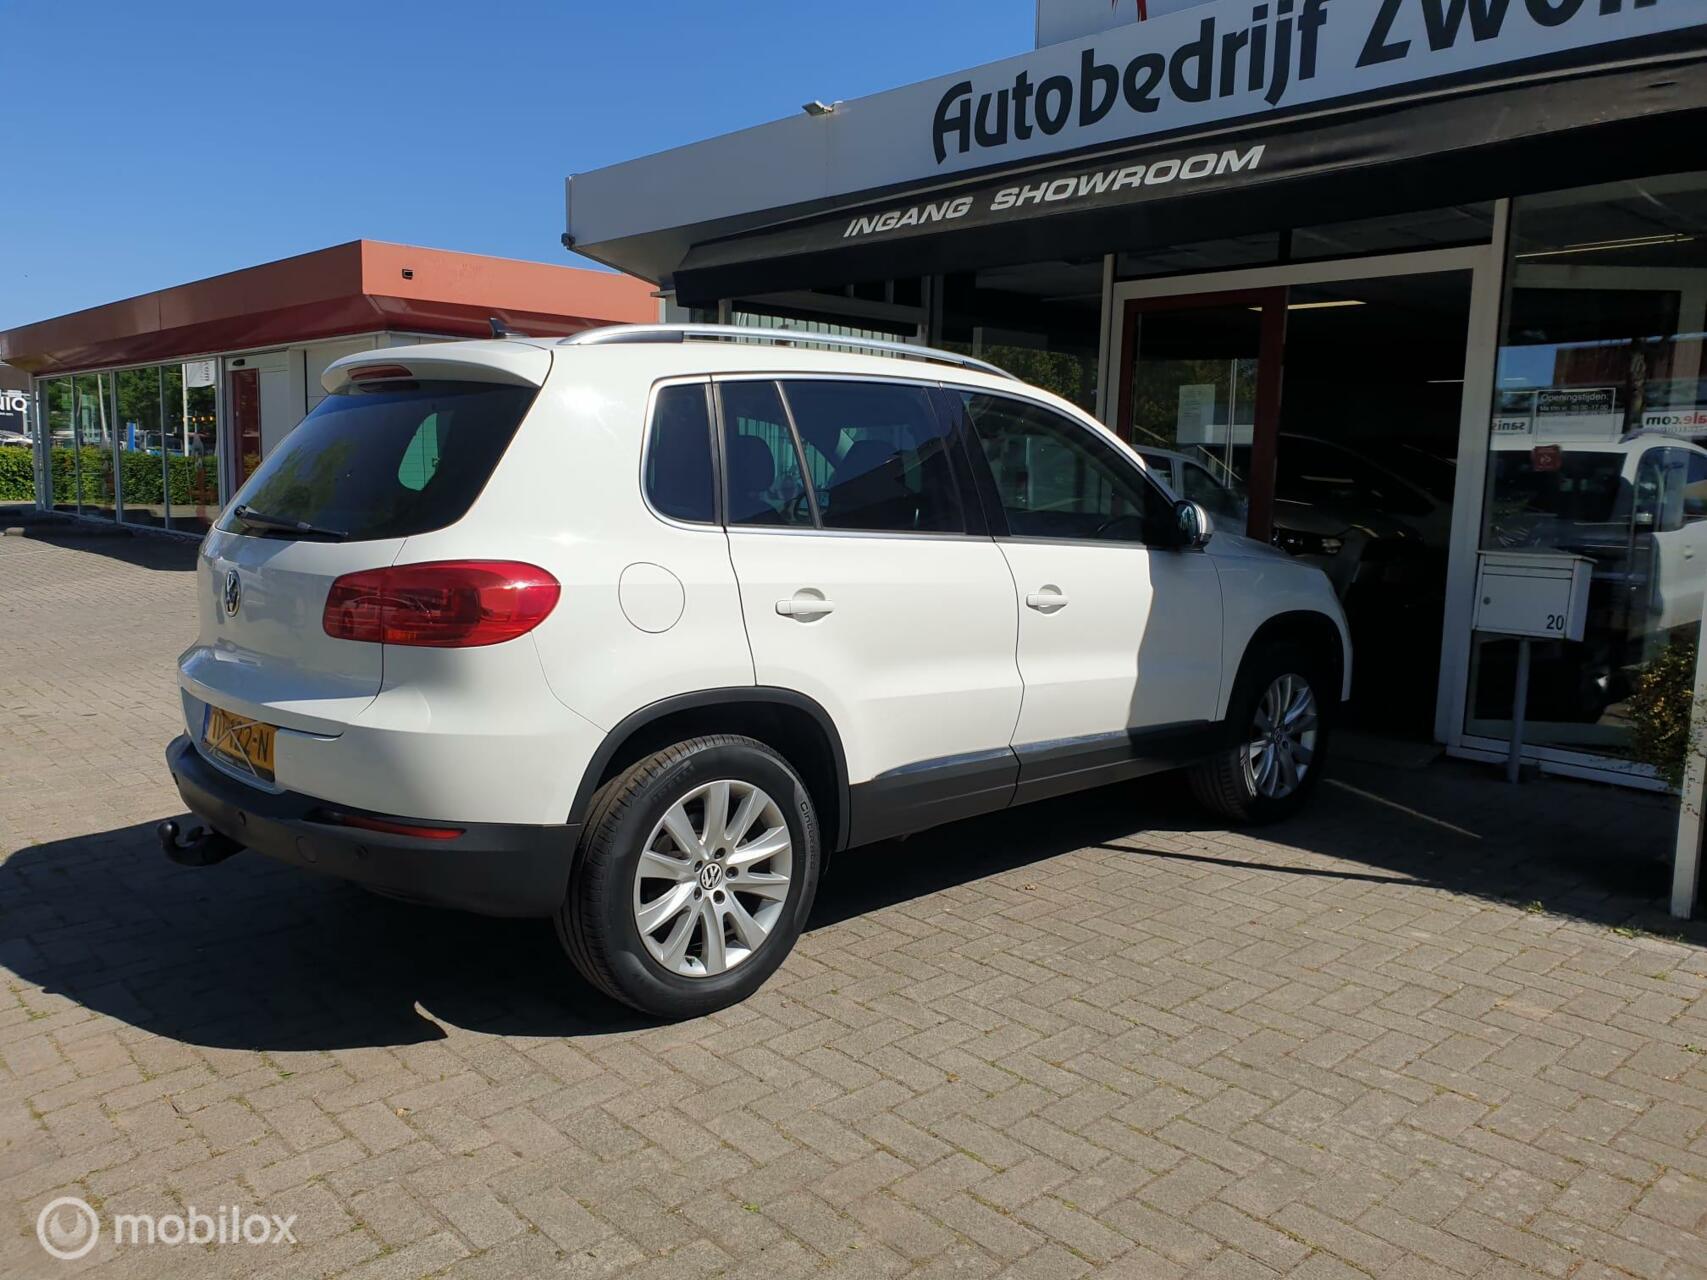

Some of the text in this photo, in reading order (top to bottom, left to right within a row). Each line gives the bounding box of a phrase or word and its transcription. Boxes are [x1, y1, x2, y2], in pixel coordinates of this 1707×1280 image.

[932, 0, 1328, 165] Autobedrijf
[843, 144, 1266, 238] INGANG SHOWROOM
[1546, 614, 1565, 631] 20
